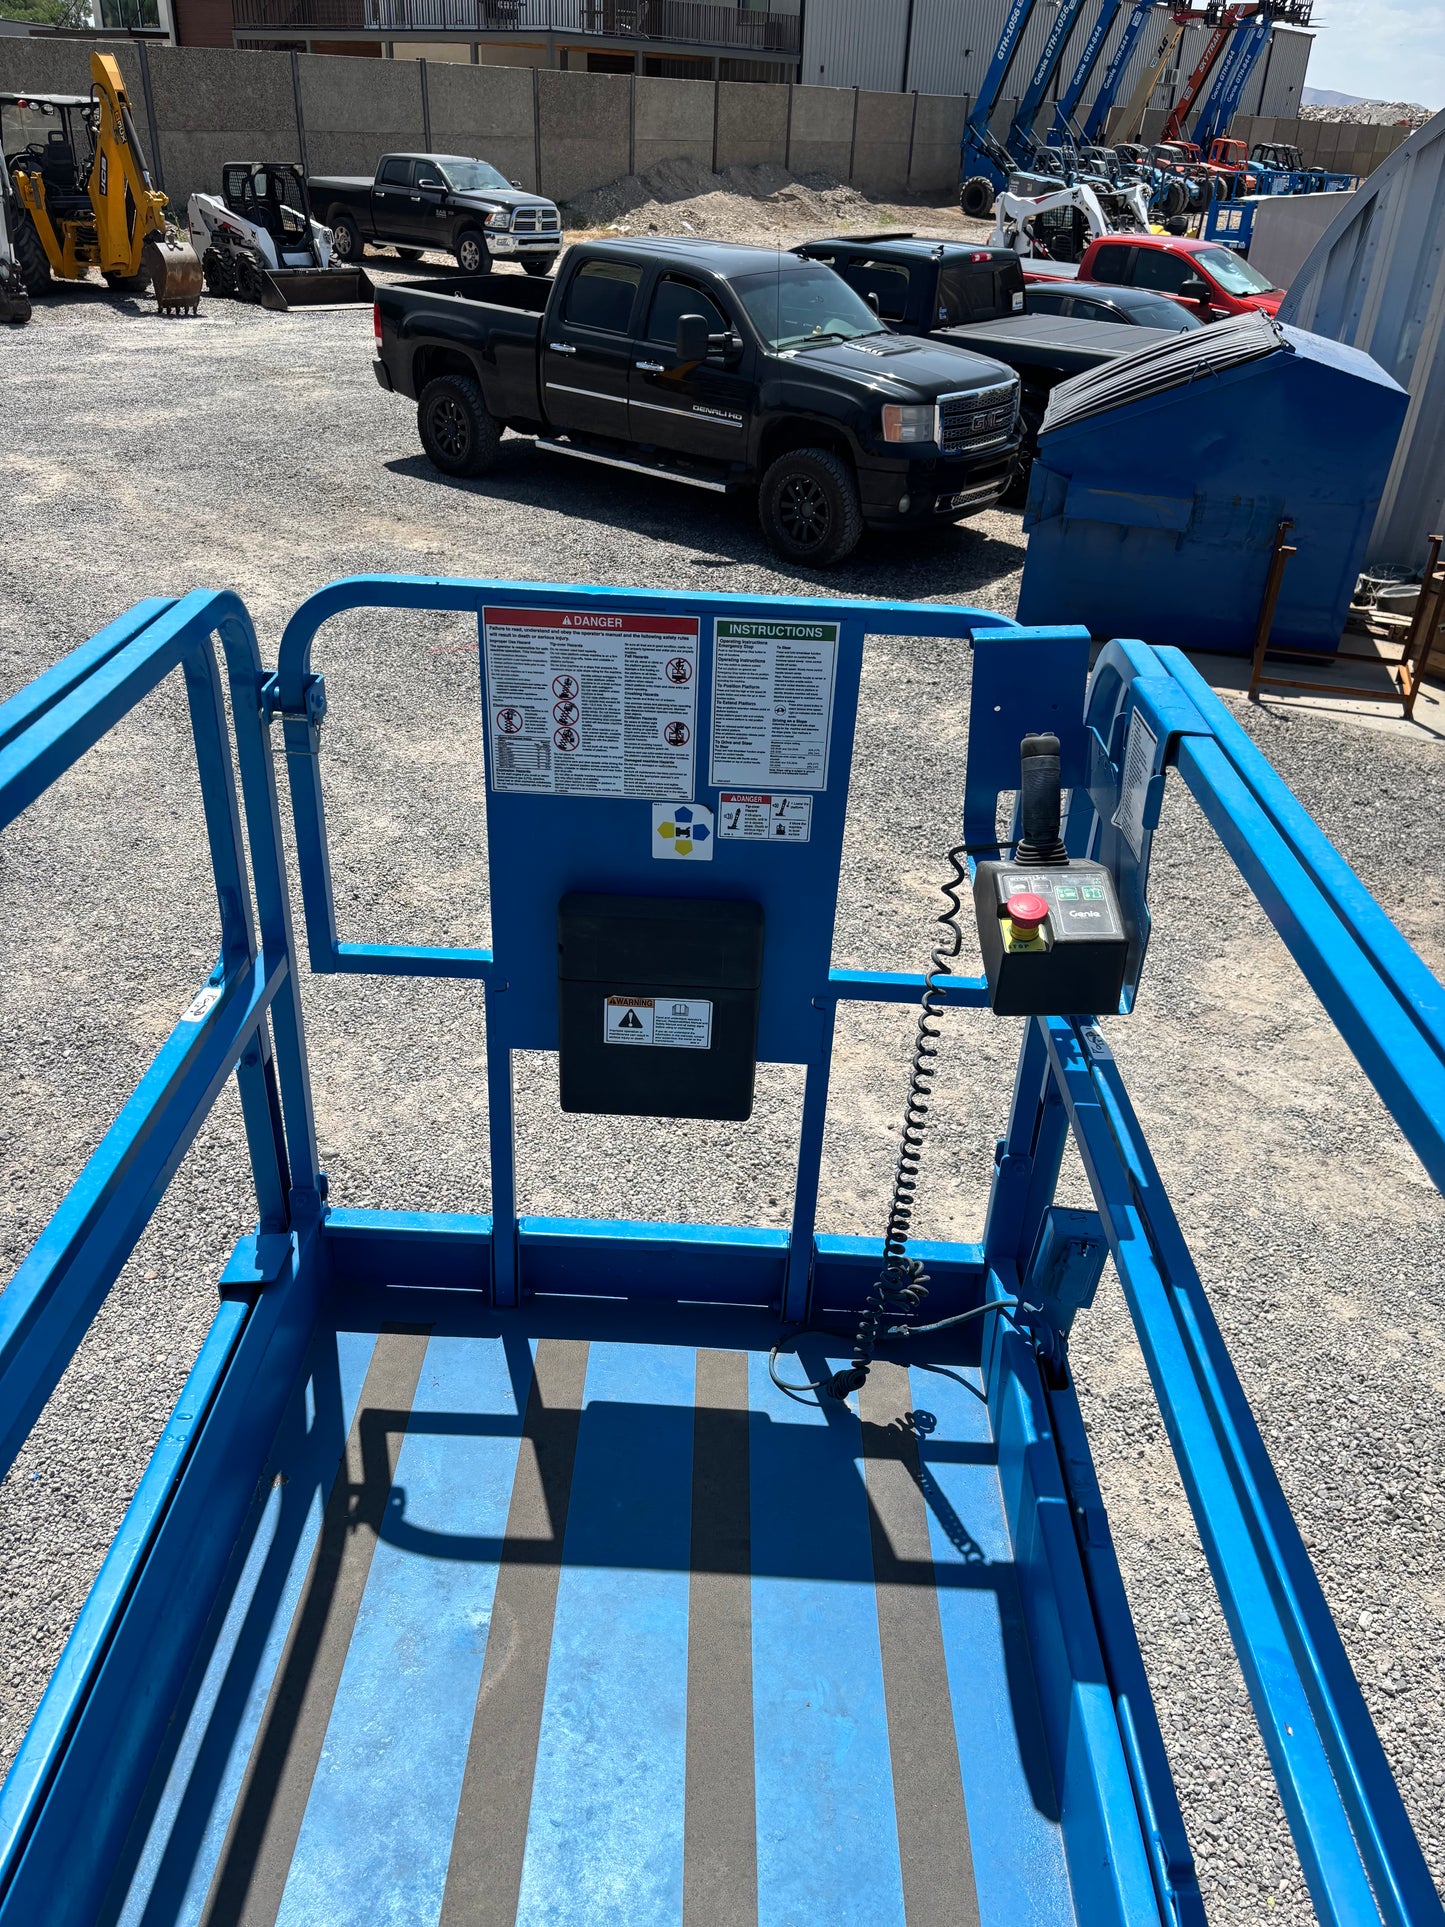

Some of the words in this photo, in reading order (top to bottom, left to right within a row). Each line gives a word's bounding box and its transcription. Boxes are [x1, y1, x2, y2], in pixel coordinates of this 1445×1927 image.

[997, 7, 1021, 60] GTH-1056
[1033, 58, 1049, 86] Genie
[1045, 4, 1070, 58] GTH-1056
[1157, 37, 1169, 59] JLG
[1073, 63, 1086, 86] Genie
[1083, 25, 1103, 62] GTH-844
[1103, 68, 1117, 89] Genie
[1113, 34, 1130, 66] GTH-844
[1198, 30, 1222, 73] SKYTRAK
[1211, 81, 1222, 100] Genie
[1219, 50, 1236, 81] GTH-844
[1226, 84, 1238, 103] Genie
[1235, 54, 1252, 84] GTH-844
[692, 404, 728, 417] DENALI
[972, 409, 1008, 431] GMC
[574, 615, 623, 628] DANGER
[729, 623, 823, 638] INSTRUCTIONS
[1069, 910, 1101, 918] Genie
[616, 998, 653, 1008] WARNING
